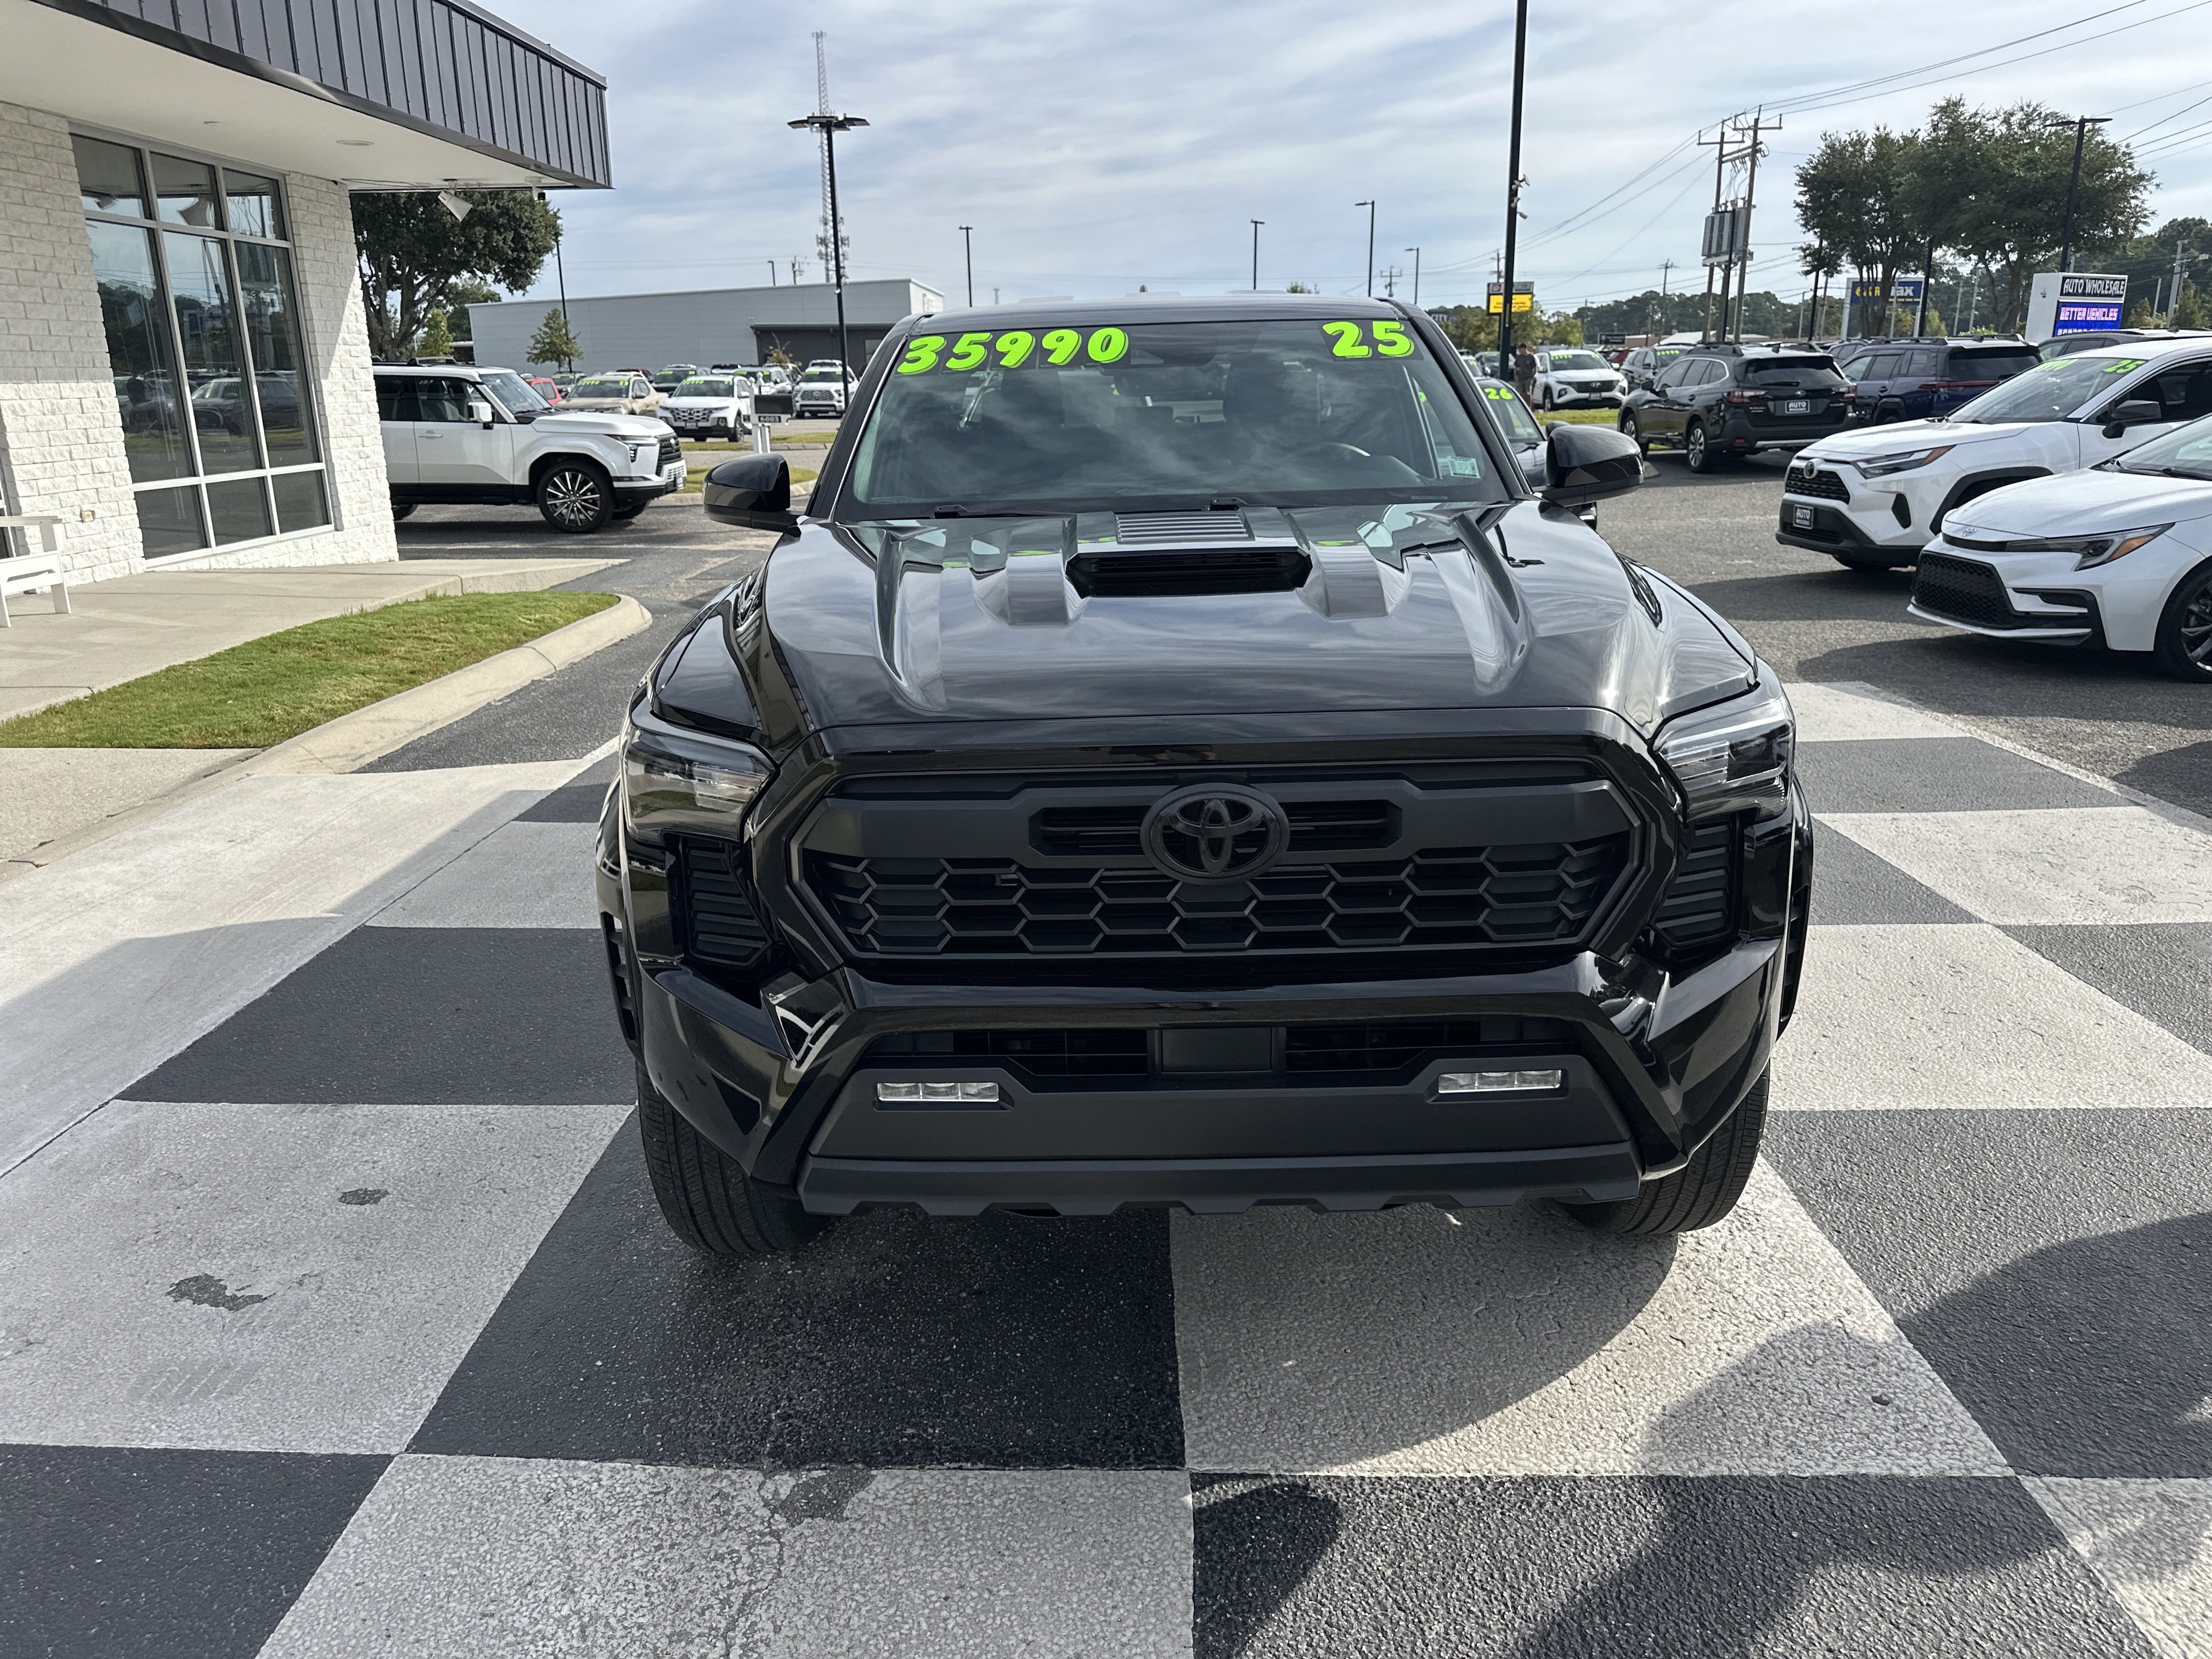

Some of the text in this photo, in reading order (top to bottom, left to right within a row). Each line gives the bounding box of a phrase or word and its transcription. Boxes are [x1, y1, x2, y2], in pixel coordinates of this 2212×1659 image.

[2063, 278, 2125, 295] AUTO WHOLESALE
[2059, 307, 2118, 321] BETTER VEHICLES
[1323, 321, 1414, 358] 25
[898, 328, 1128, 375] 35990
[2103, 359, 2146, 374] 25
[1484, 388, 1513, 400] 26
[1796, 508, 1810, 520] AUTO
